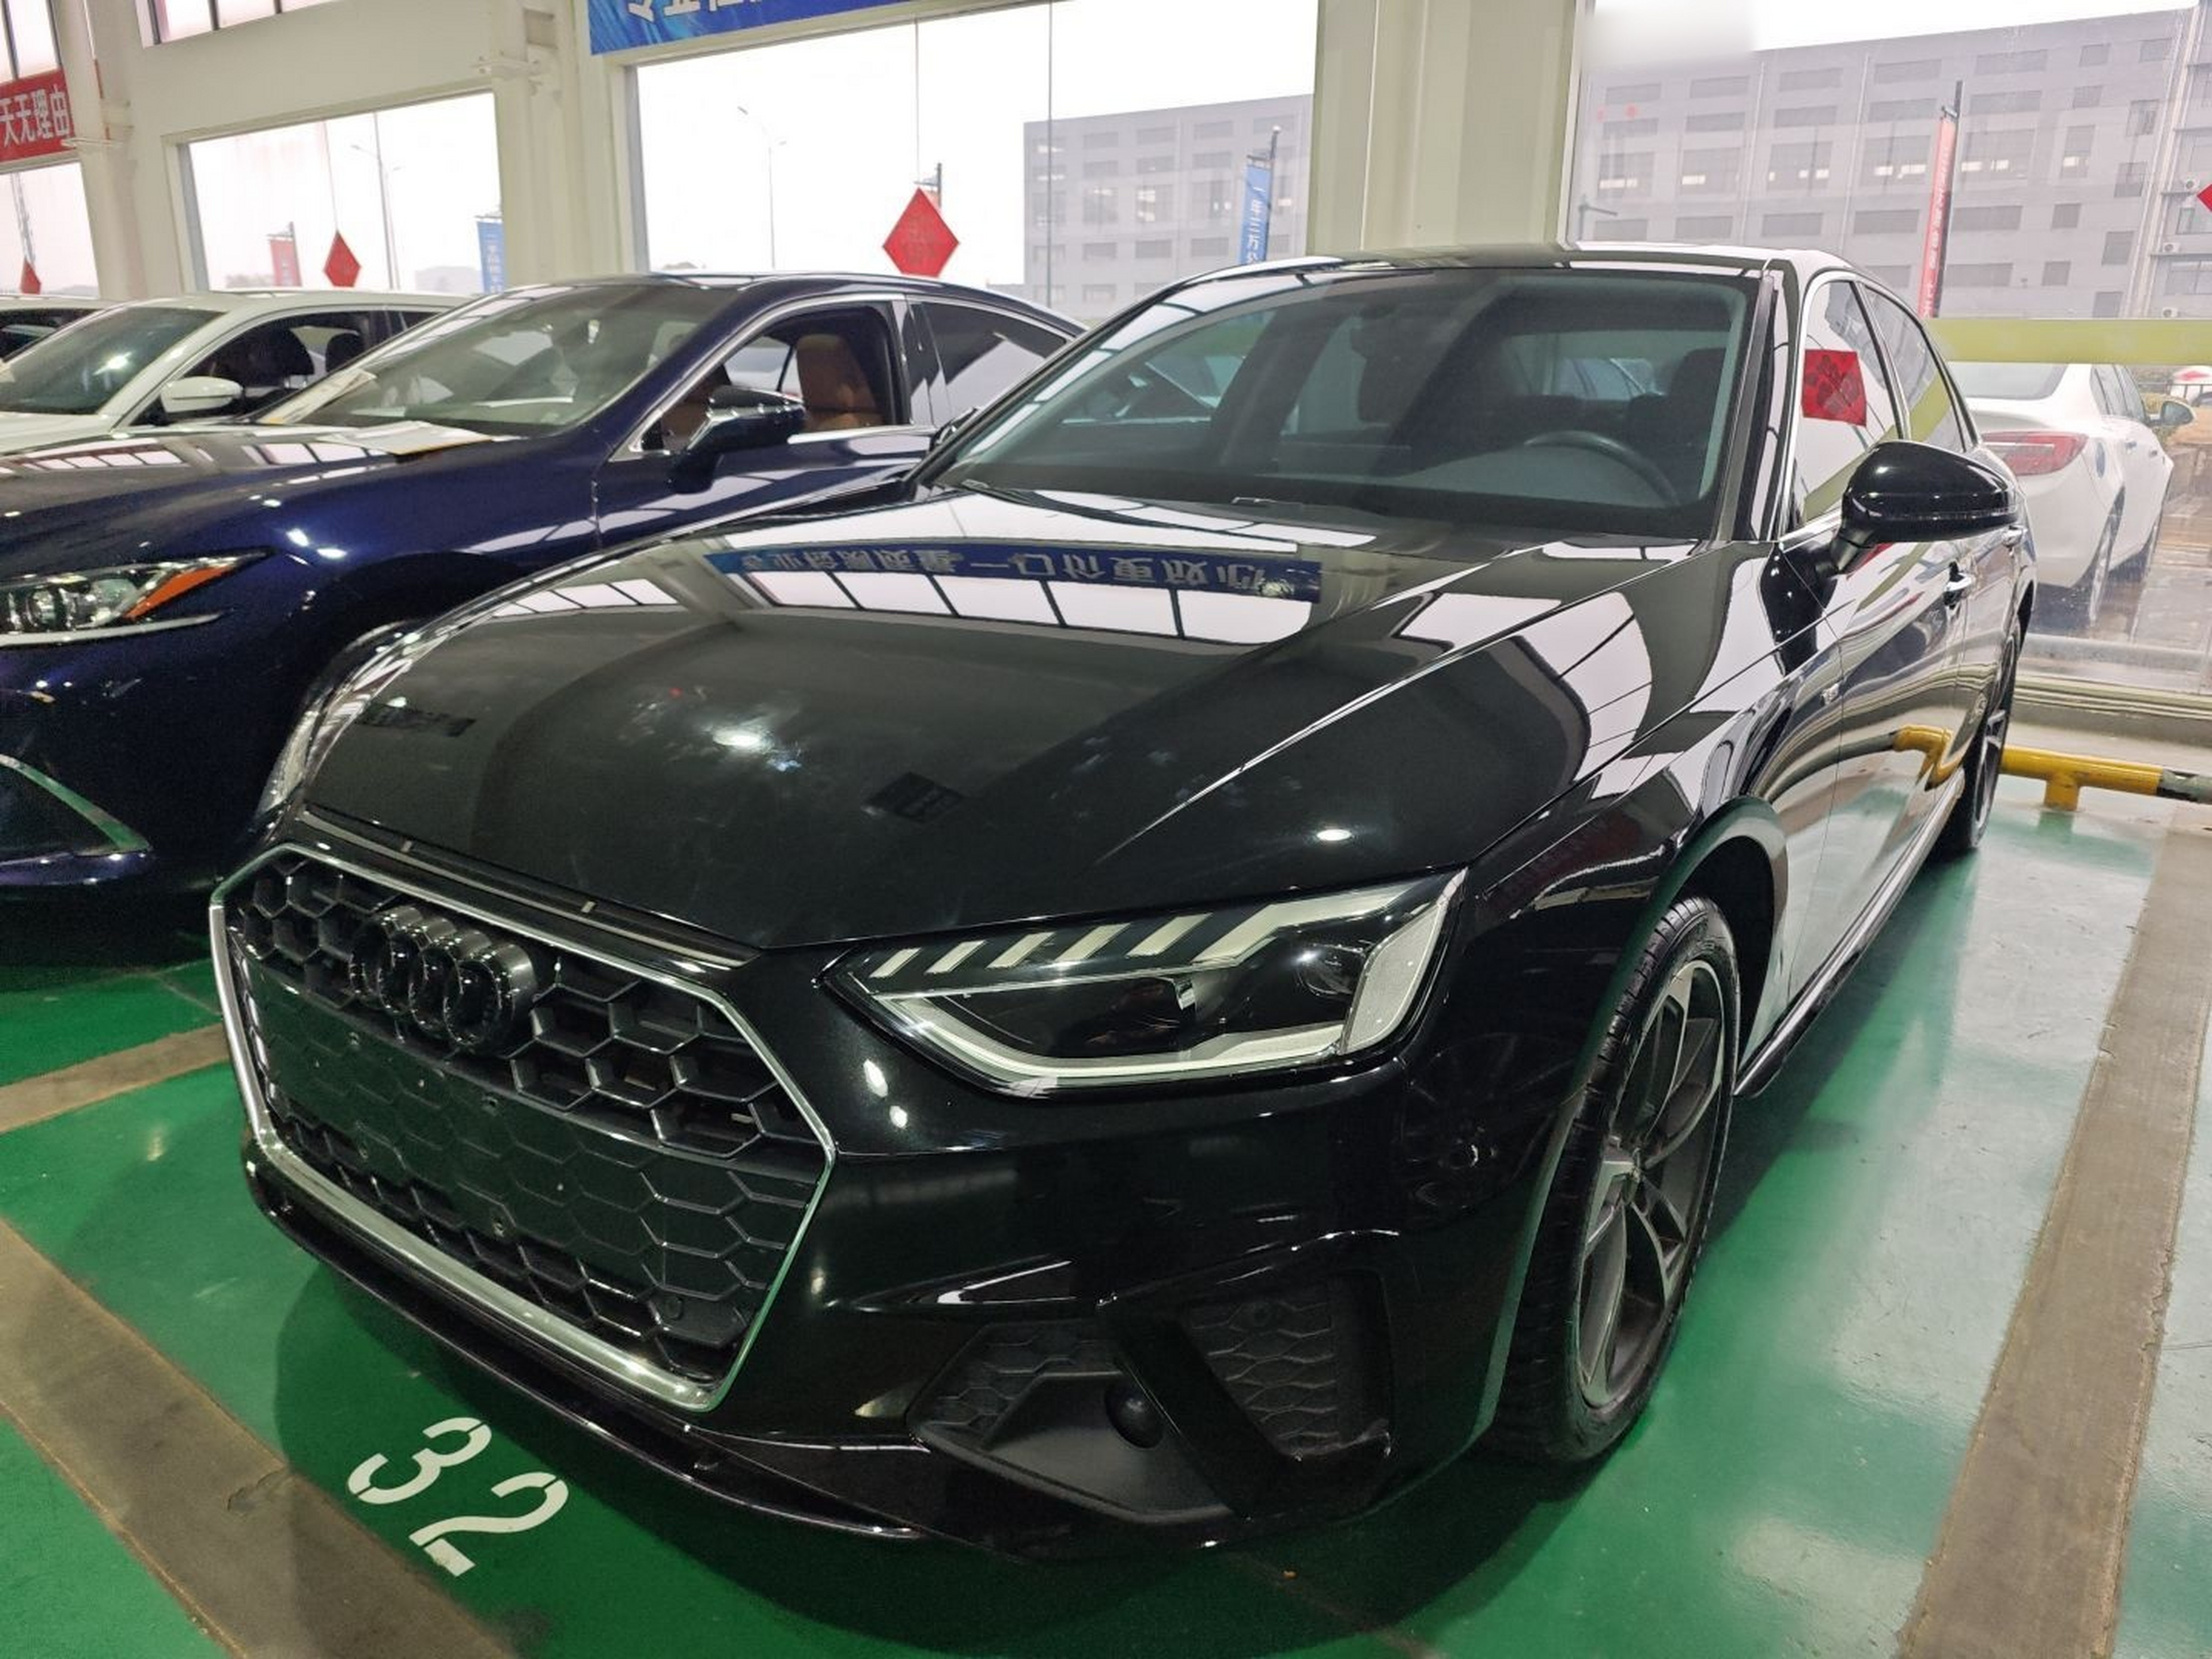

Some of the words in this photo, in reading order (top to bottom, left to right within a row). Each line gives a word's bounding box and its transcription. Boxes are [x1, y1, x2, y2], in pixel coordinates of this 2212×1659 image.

[0, 83, 70, 148] 天无理由
[347, 1416, 569, 1577] 32
